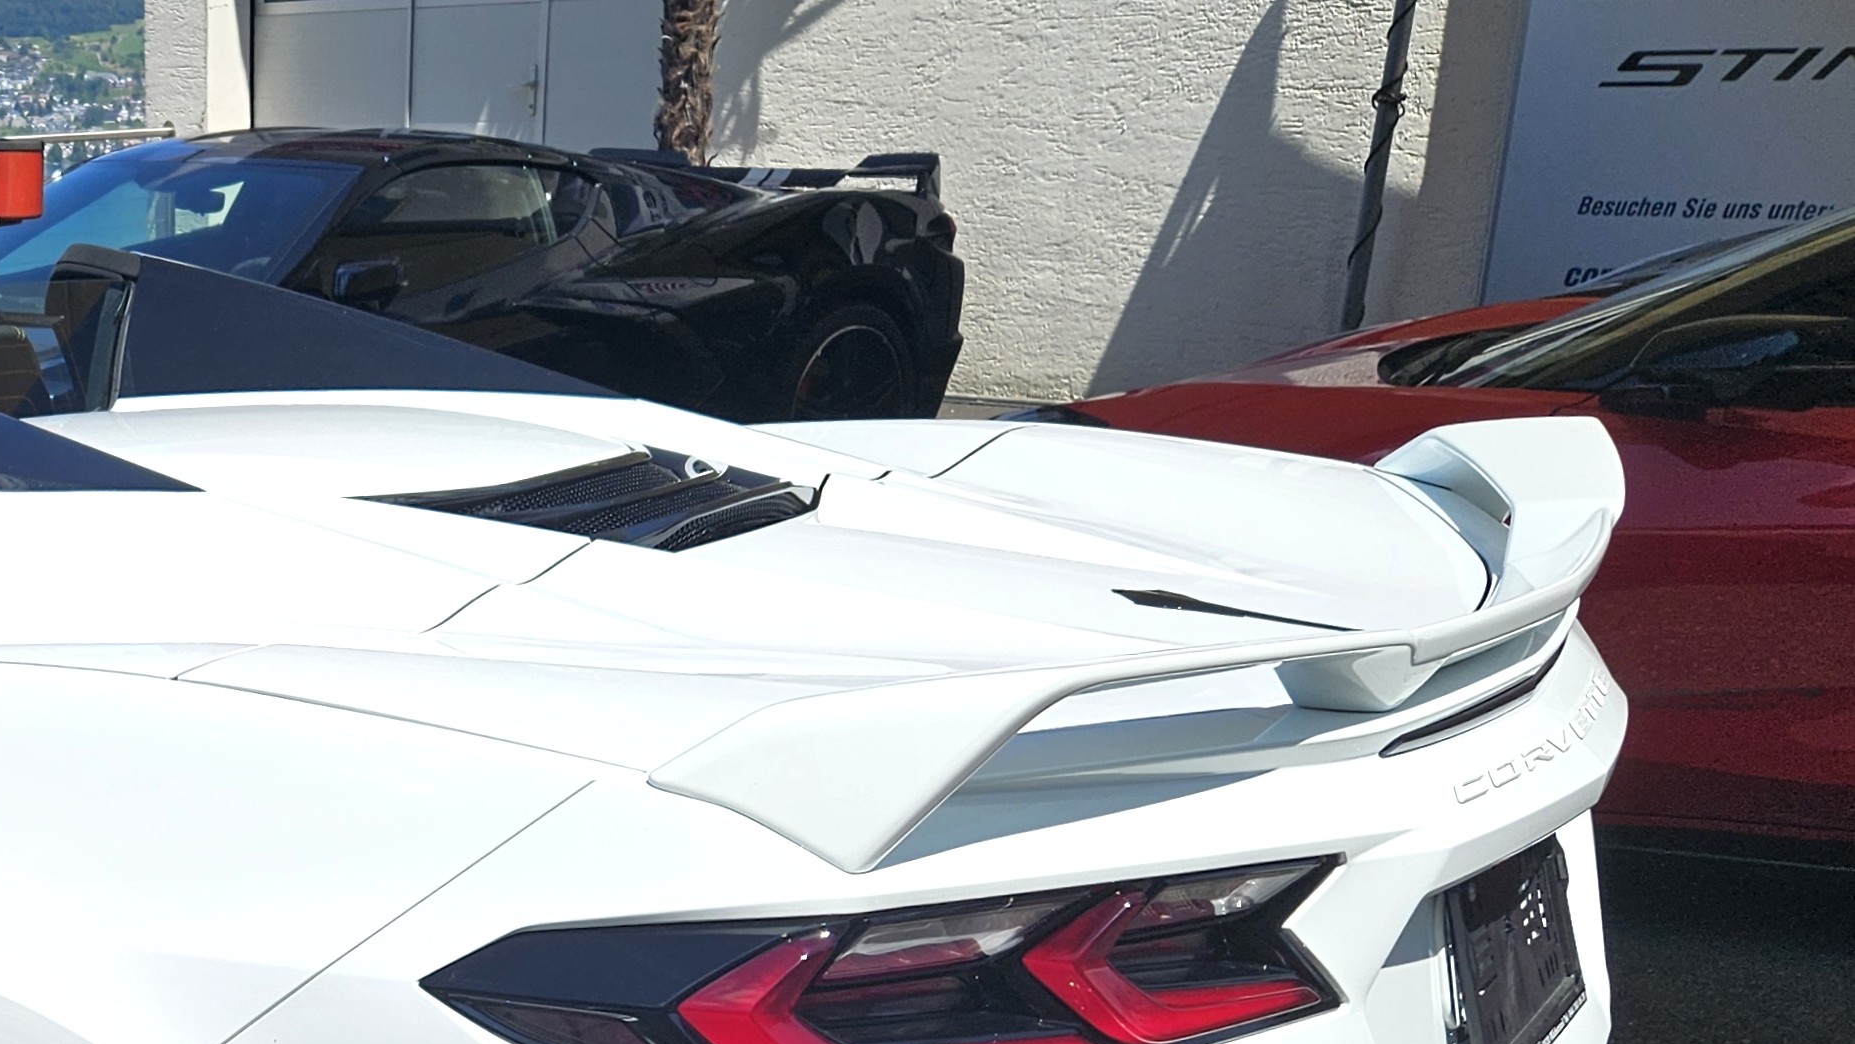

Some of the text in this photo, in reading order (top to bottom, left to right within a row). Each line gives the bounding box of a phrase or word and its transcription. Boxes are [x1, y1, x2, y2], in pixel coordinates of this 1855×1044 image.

[1577, 196, 1676, 218] Besuchen
[1682, 198, 1717, 219] Sie
[1722, 202, 1763, 220] uns
[1453, 669, 1610, 804] CORVETTE
